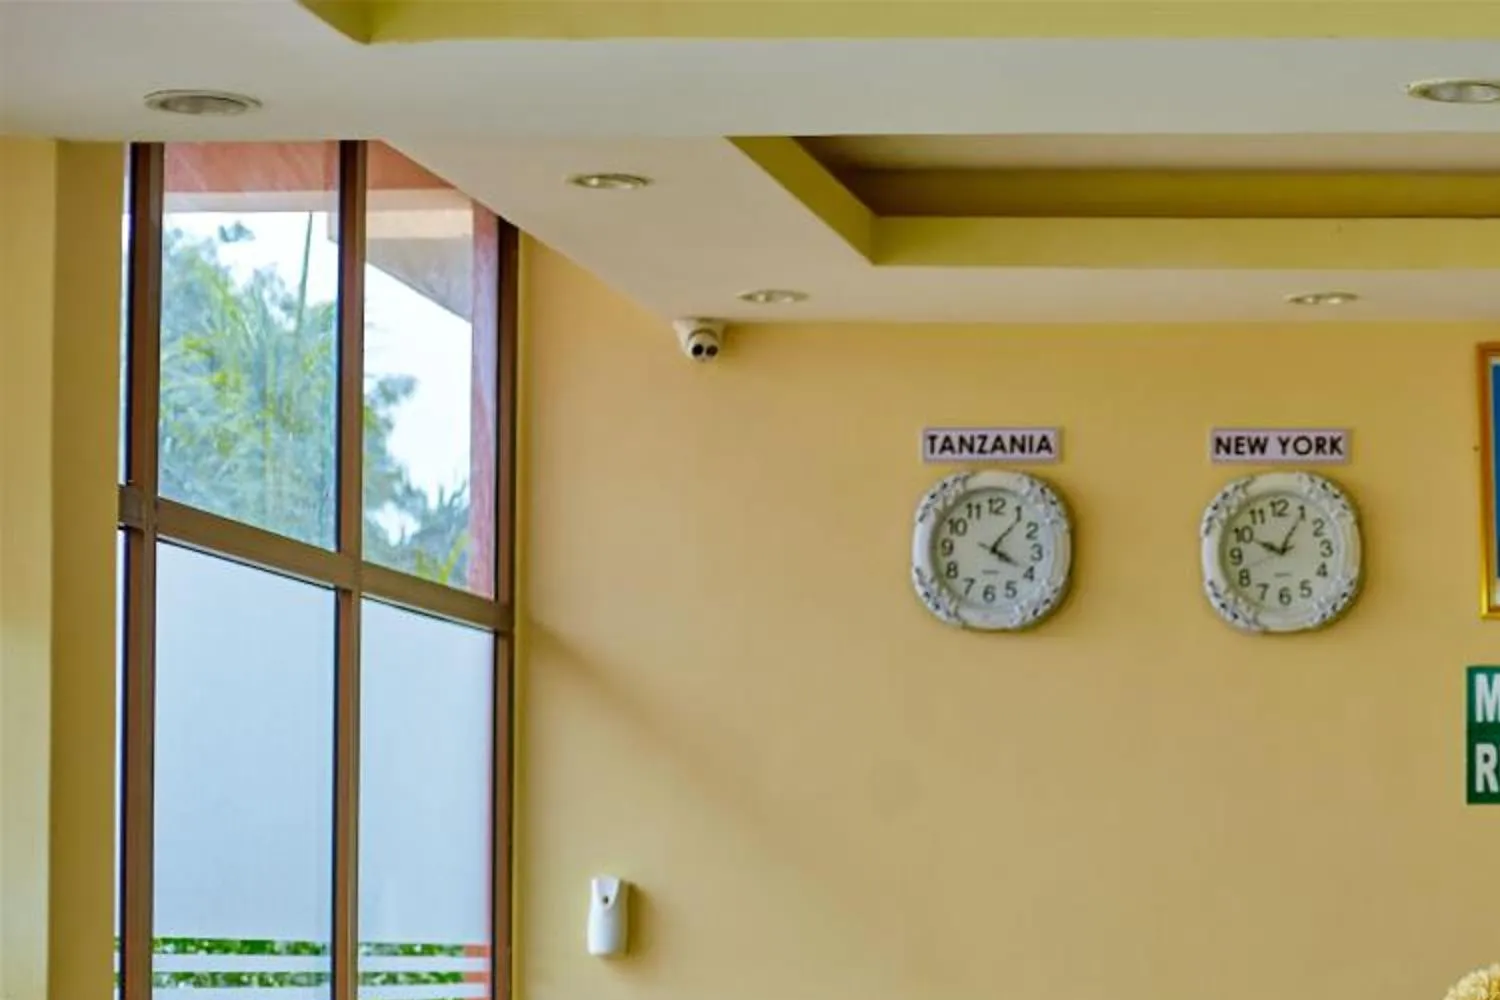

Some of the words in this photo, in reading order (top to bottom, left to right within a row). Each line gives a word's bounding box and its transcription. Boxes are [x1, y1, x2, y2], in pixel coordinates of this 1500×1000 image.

[928, 434, 1053, 455] TANZANIA
[1214, 435, 1269, 455] NEW
[1277, 435, 1343, 456] YORK
[967, 503, 981, 520] 11
[988, 498, 1006, 515] 12
[1016, 506, 1022, 522] 1
[1270, 499, 1289, 517] 12
[1299, 505, 1306, 520] 1
[1249, 509, 1265, 525] 11
[948, 518, 967, 536] 10
[1026, 522, 1039, 539] 2
[1234, 526, 1253, 543] 10
[1312, 518, 1325, 537] 2
[941, 538, 954, 556] 9
[1030, 544, 1043, 561] 3
[1319, 540, 1333, 557] 3
[1230, 547, 1243, 565] 9
[946, 561, 958, 579] 8
[1023, 566, 1035, 581] 4
[1238, 568, 1250, 587] 8
[1316, 563, 1327, 577] 4
[964, 578, 975, 595] 7
[983, 585, 995, 602] 6
[1005, 581, 1017, 598] 5
[1257, 583, 1269, 600] 7
[1300, 579, 1312, 598] 5
[1279, 587, 1291, 606] 6
